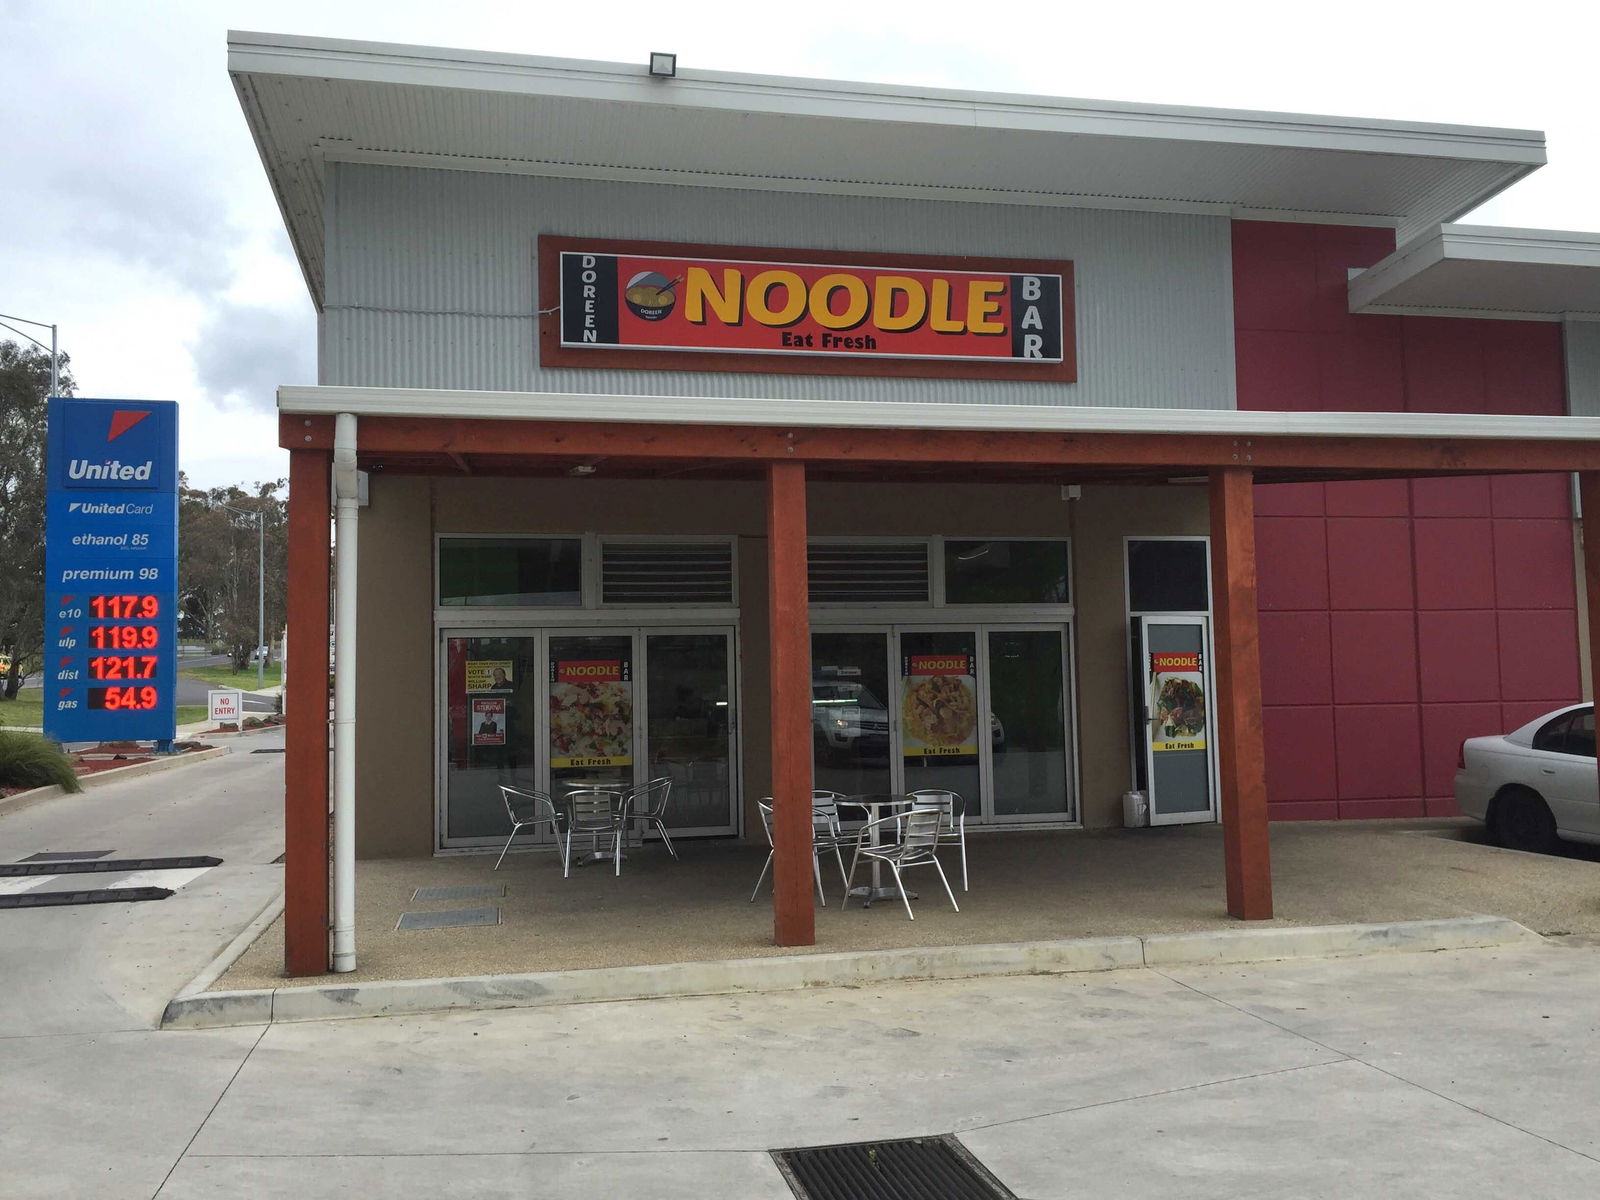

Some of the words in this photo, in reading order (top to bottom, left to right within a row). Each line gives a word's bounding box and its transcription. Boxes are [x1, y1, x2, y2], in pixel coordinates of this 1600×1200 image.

[581, 255, 598, 343] DOREEN
[684, 266, 1006, 335] NOODLE
[1021, 276, 1044, 359] BAR
[781, 331, 814, 348] Eat
[821, 333, 877, 350] Fresh
[68, 459, 152, 481] United
[72, 533, 127, 546] ethanol
[131, 533, 149, 546] 85
[62, 568, 134, 583] premium
[139, 568, 159, 580] 98
[59, 608, 81, 619] e10
[91, 595, 159, 619] 117.9
[58, 636, 76, 649] ulp
[91, 626, 159, 649] 119.9
[57, 669, 79, 680] dist
[90, 656, 158, 679] 121.7
[566, 665, 620, 676] NOODLE
[919, 660, 966, 670] NOODLE
[1159, 657, 1197, 666] NOODLE
[57, 698, 78, 711] gas
[104, 686, 158, 711] 54.9
[214, 707, 236, 715] ENTRY
[587, 758, 611, 766] Fresh
